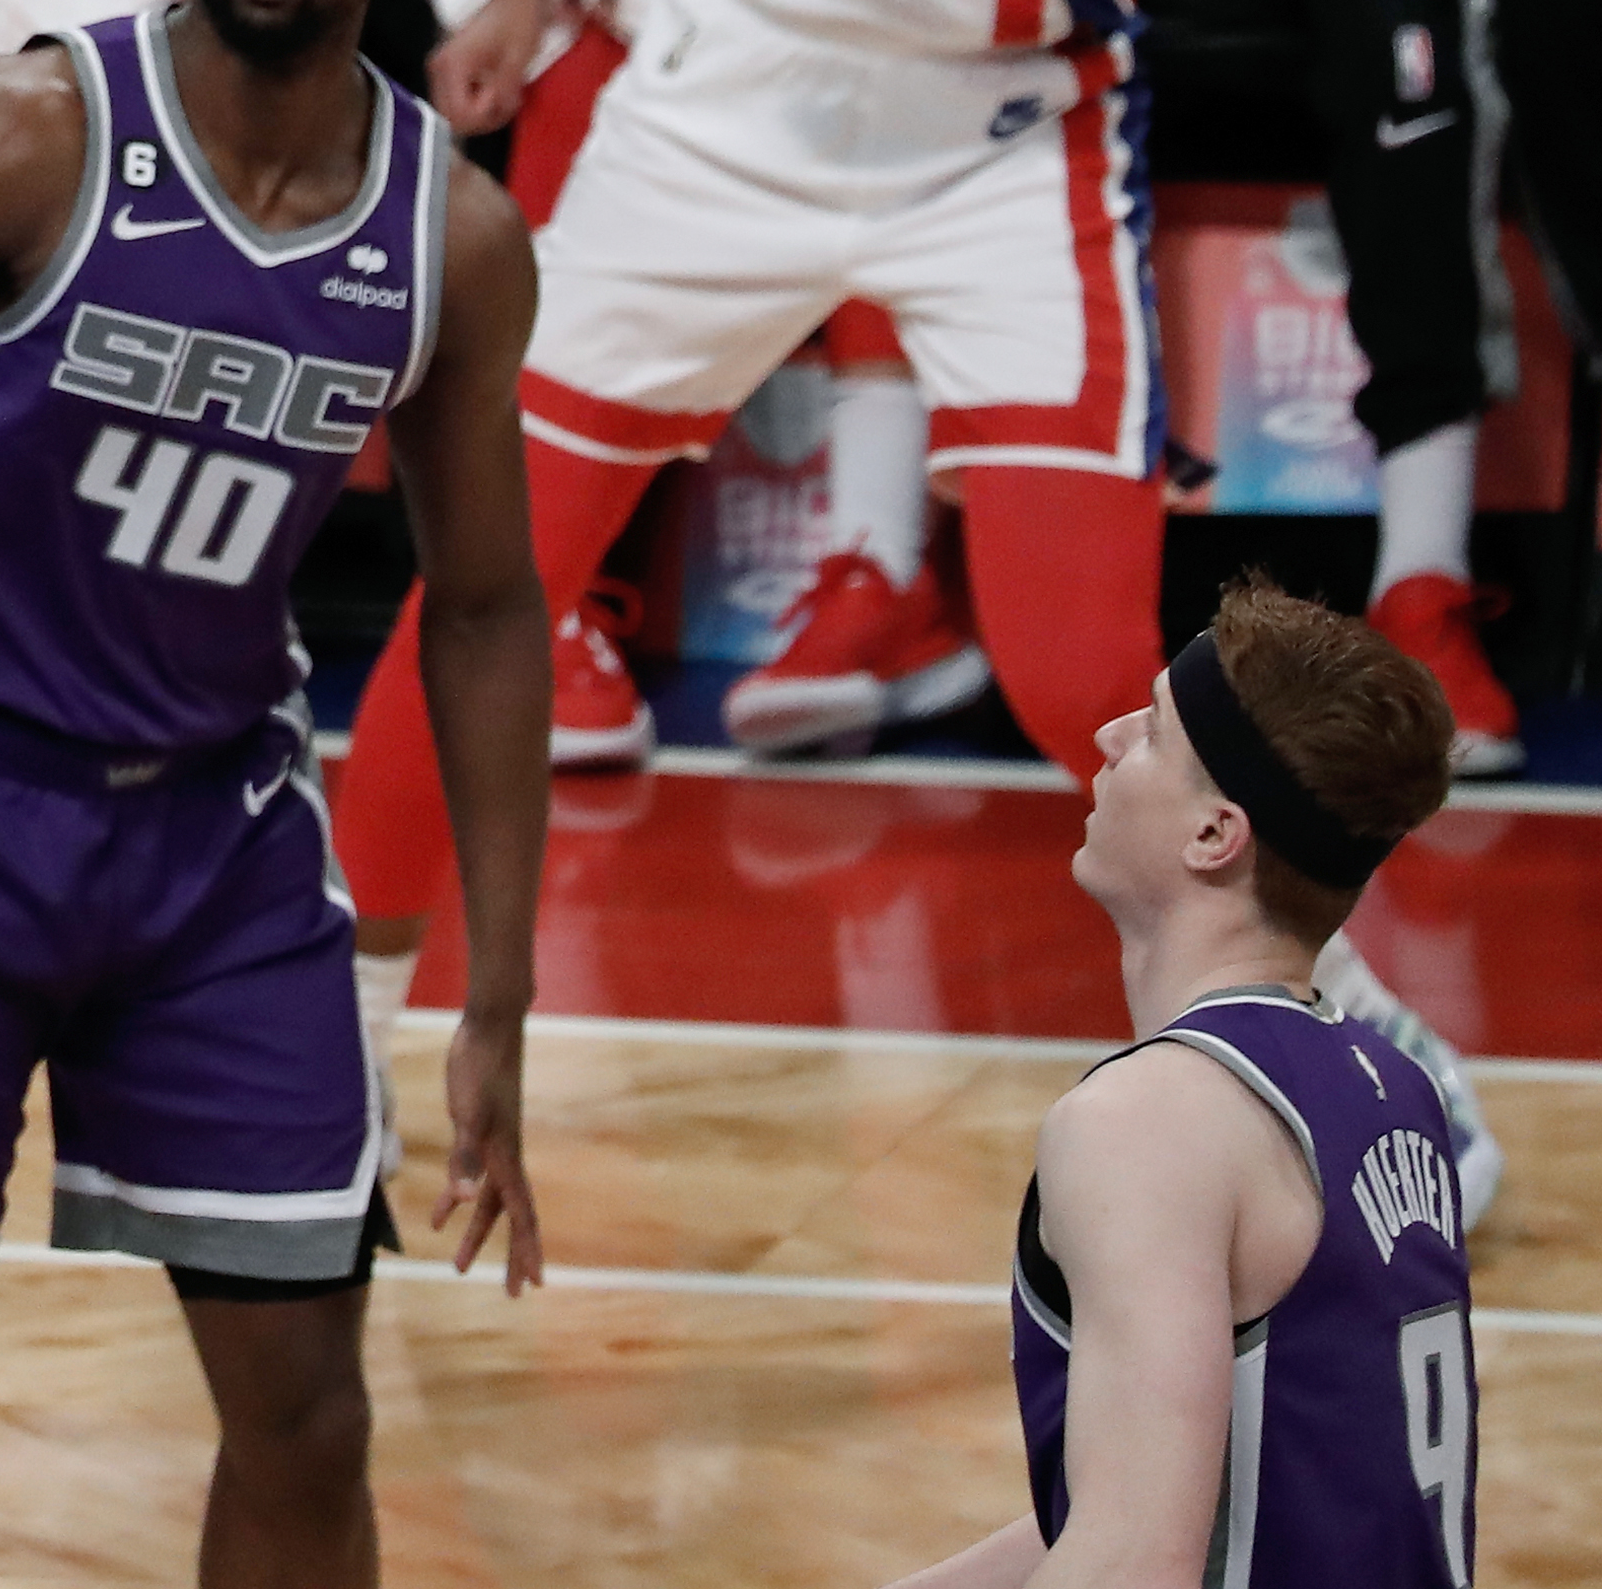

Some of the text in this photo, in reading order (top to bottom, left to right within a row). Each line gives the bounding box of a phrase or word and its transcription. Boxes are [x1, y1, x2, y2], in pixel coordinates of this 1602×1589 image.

[121, 141, 158, 191] 6
[318, 274, 409, 311] dialpad
[49, 300, 395, 455] SAC
[73, 424, 296, 589] 40
[1397, 1299, 1479, 1589] 9
